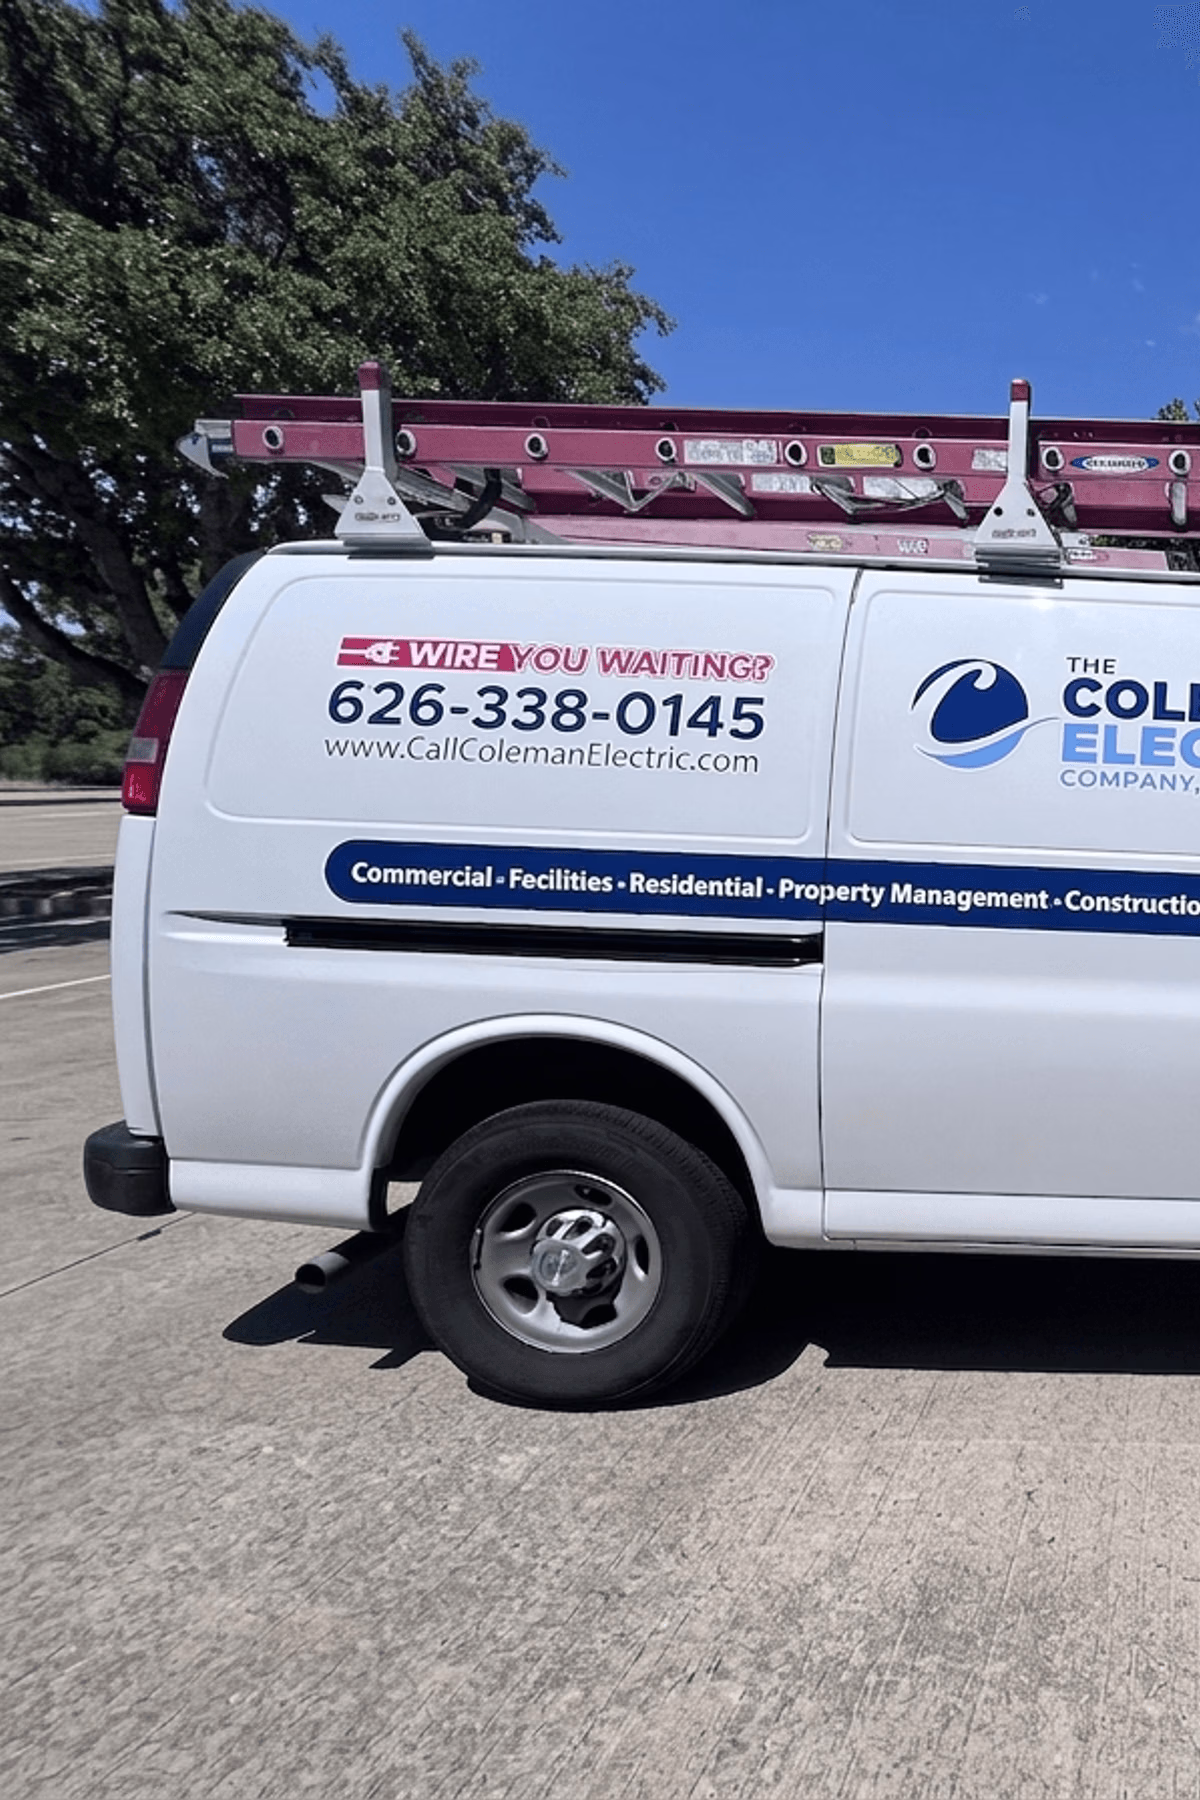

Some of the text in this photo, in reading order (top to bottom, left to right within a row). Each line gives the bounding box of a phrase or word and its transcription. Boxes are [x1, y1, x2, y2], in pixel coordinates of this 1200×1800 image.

[409, 640, 774, 682] WIRE YOU WAITING?
[1066, 656, 1116, 675] THE
[327, 679, 765, 740] 626-338-0145
[324, 735, 759, 774] www.CallColemanElectric.com
[350, 860, 493, 888] Commercial
[629, 873, 763, 899] Residential
[778, 878, 886, 908] Property
[890, 882, 1049, 911] Management
